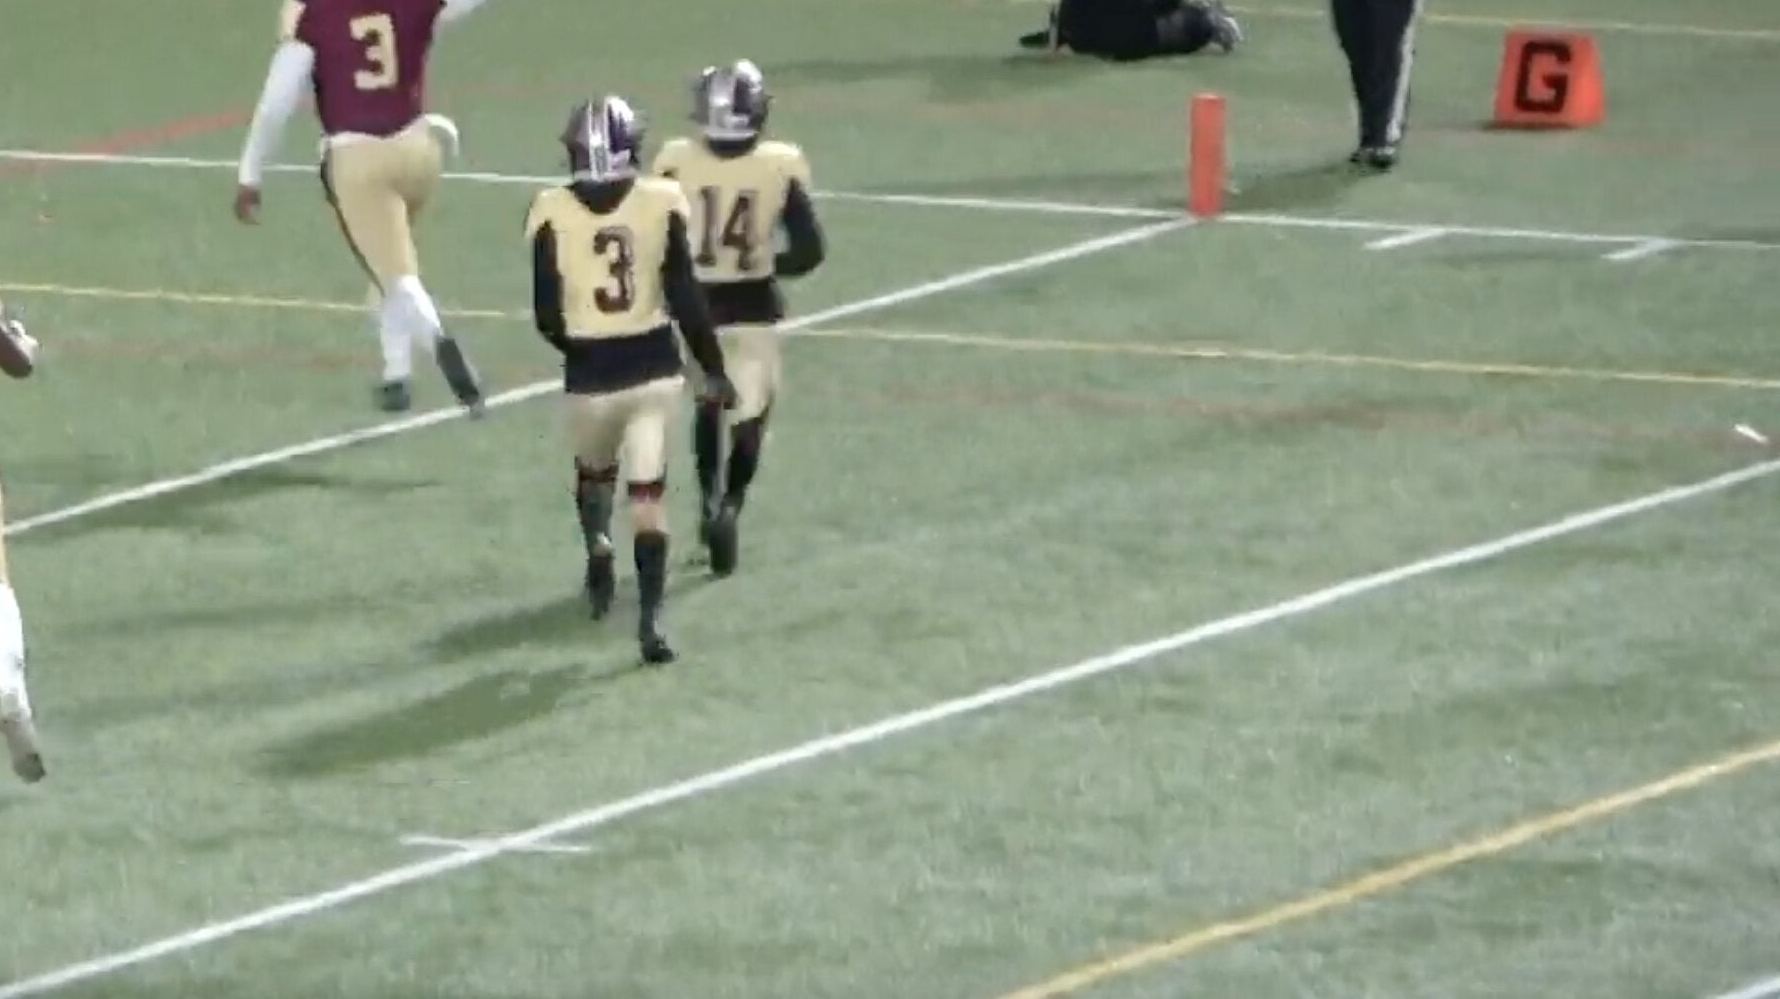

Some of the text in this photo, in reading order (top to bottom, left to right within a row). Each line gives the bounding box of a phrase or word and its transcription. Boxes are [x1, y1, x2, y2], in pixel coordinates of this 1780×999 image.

[349, 13, 399, 89] 3
[1515, 41, 1571, 113] G
[593, 223, 635, 314] 3
[696, 185, 760, 271] 14
